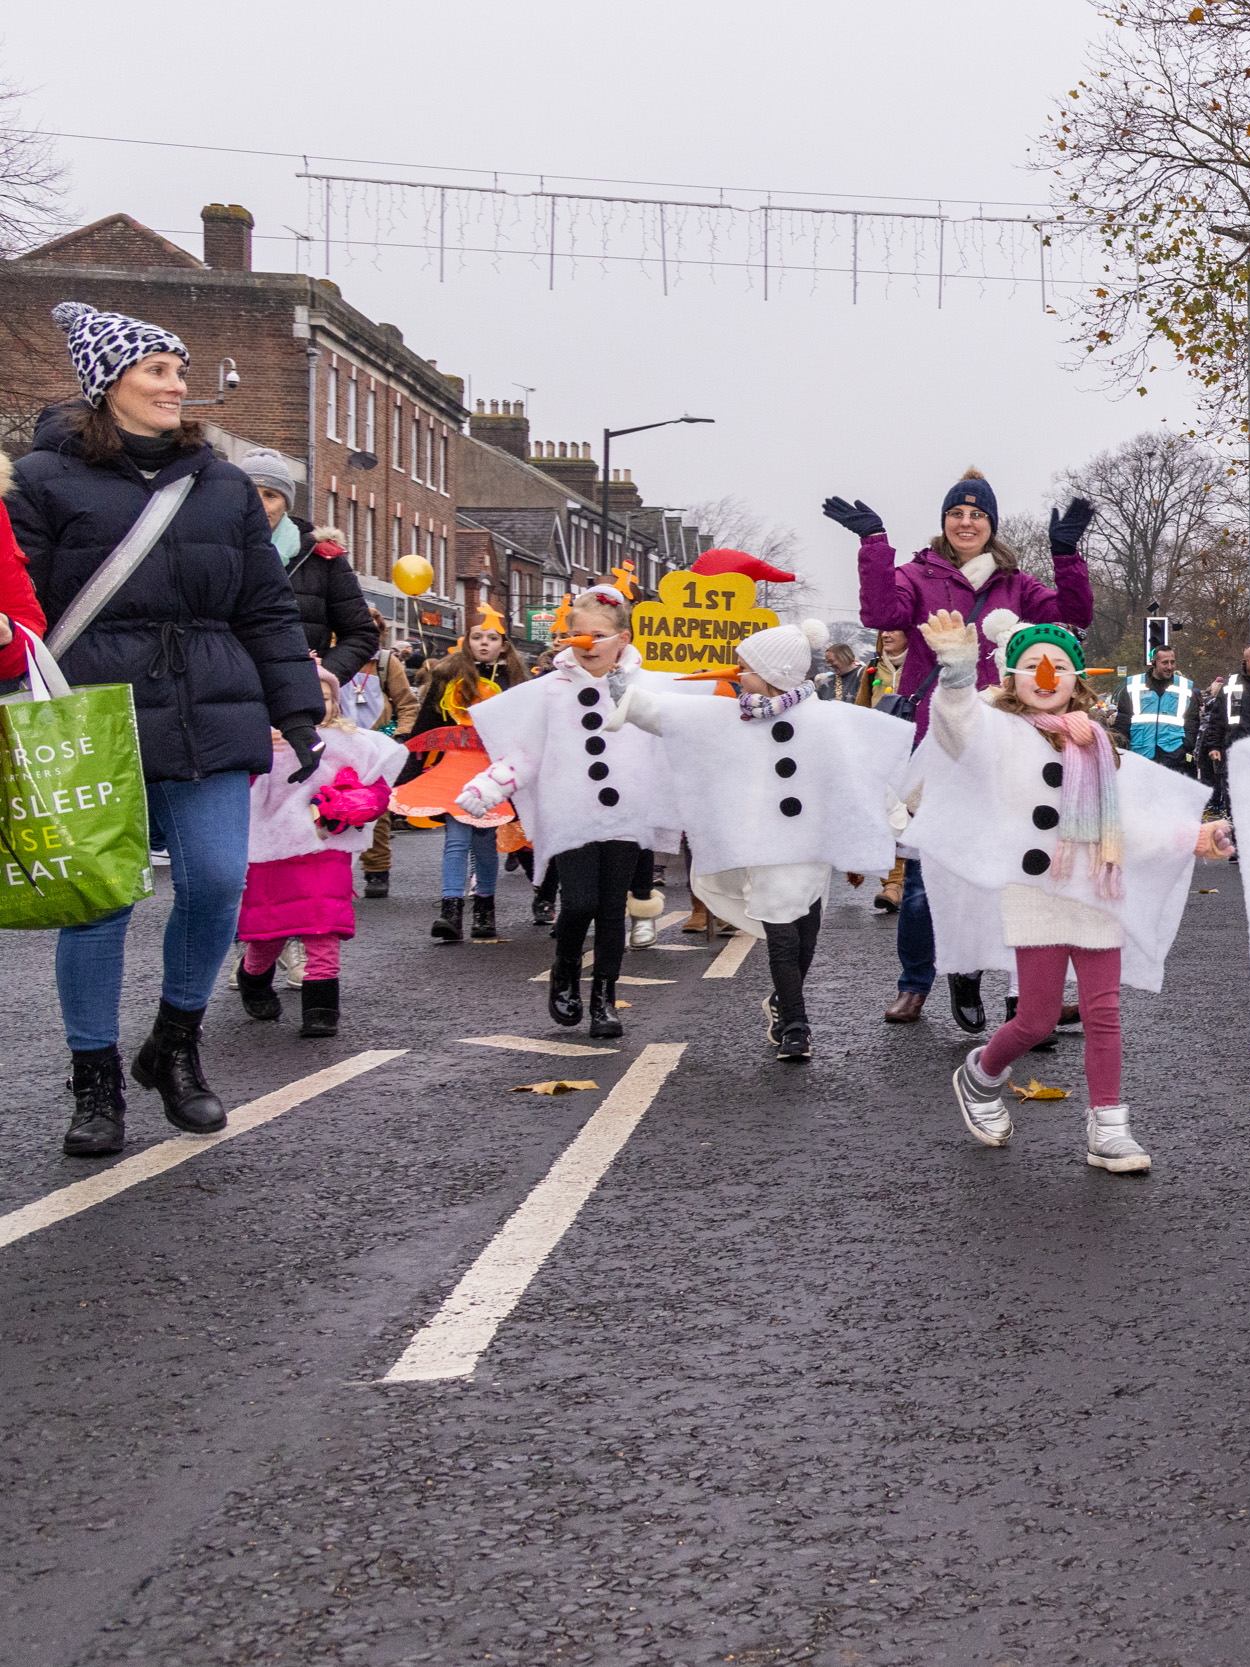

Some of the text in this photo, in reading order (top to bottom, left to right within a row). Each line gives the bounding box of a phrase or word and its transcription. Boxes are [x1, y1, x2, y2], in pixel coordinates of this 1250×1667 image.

[682, 581, 736, 612] 1ST
[638, 615, 769, 642] HARPENDEN
[1034, 627, 1066, 640] HO
[13, 736, 95, 767] ROSE
[4, 855, 83, 887] EAT.
